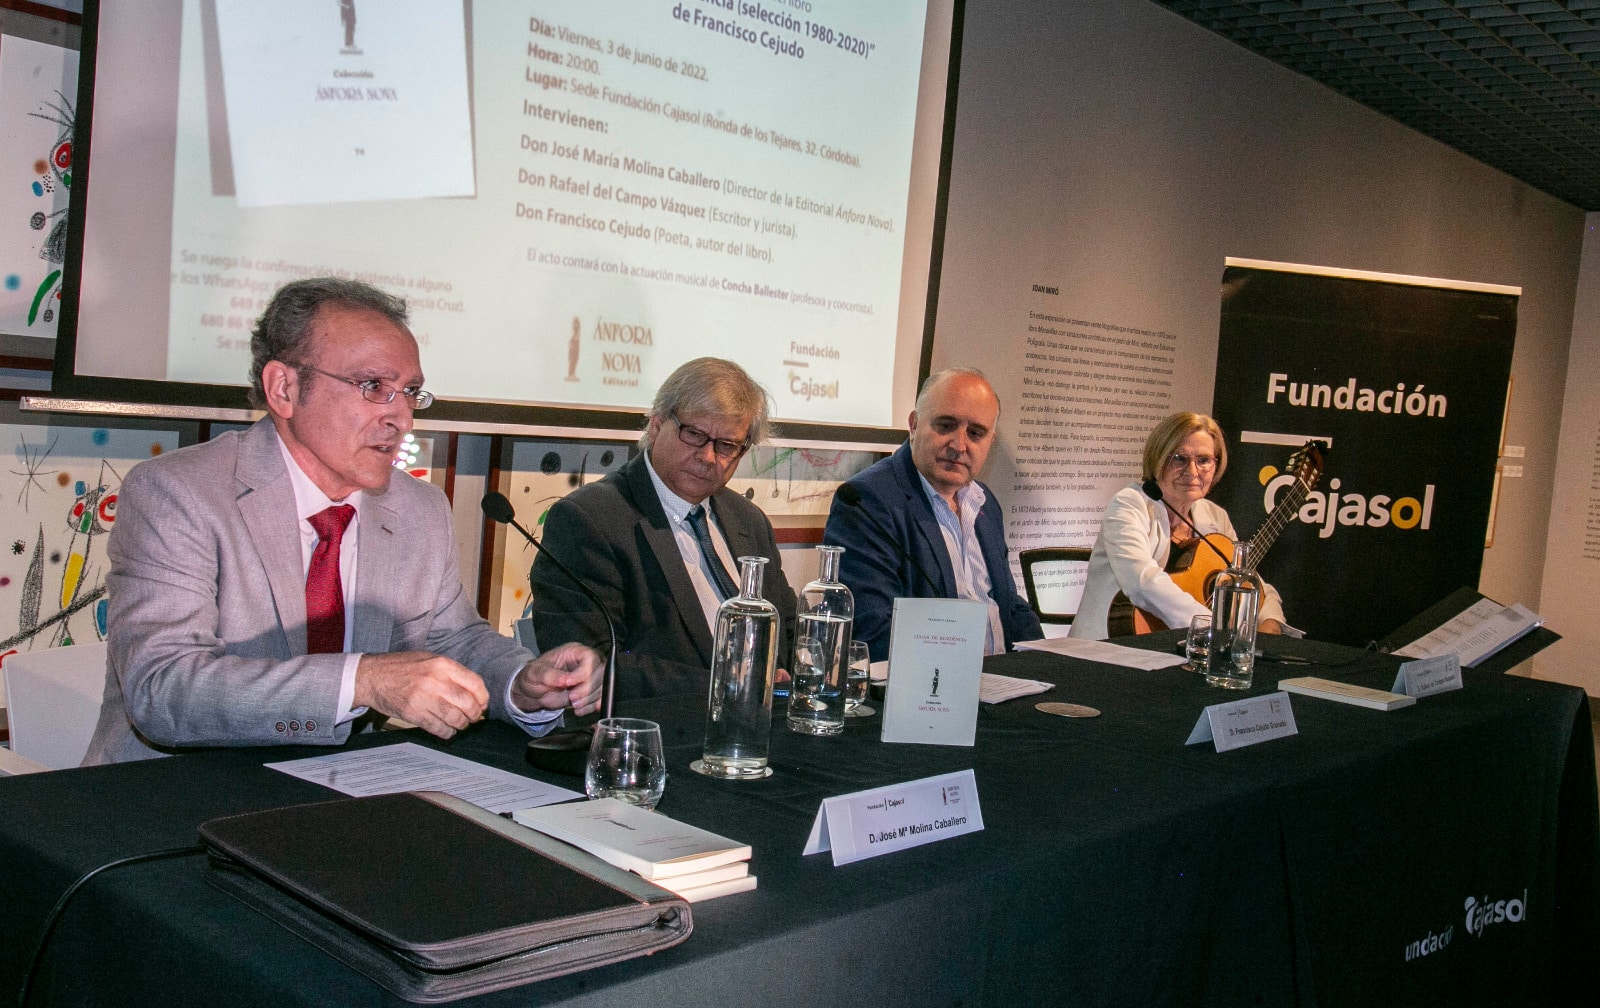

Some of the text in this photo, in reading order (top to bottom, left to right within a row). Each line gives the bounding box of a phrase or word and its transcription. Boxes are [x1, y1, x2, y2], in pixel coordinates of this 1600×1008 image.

[672, 3, 804, 59] de Francisco Cejudo
[738, 0, 801, 33] (selección
[527, 42, 601, 75] Hora: 20:00.
[529, 16, 709, 82] Día: Viernes, 3 de junio de 2022.
[523, 99, 609, 133] Intervienen:
[526, 66, 567, 91] Lugar:
[570, 77, 599, 99] Sede
[602, 87, 661, 114] Fundación
[663, 102, 700, 124] Cajasol
[703, 112, 738, 134] (Ronda
[740, 123, 753, 138] de
[755, 127, 768, 142] los
[770, 130, 802, 153] Tejares,
[820, 144, 861, 168] Córdoba).
[520, 134, 895, 233] Don José María Molina Caballero (Director de la Editorial Ánfora Nova).
[518, 168, 798, 240] Don Rafael del Campo Vázquez (Escritor y jurista).
[515, 202, 775, 263] Don Francisco Cejudo (Poeta, autor del libro).
[416, 277, 452, 293] alguno
[527, 247, 875, 316] El acto contará con la actuación musical de Concha Ballester (profesora y concertista).
[1032, 284, 1045, 294] JOAN
[593, 315, 653, 347] ÁNFORA
[602, 352, 641, 374] NOVA
[790, 340, 840, 360] Fundación
[788, 373, 839, 402] Cajasol
[1267, 372, 1448, 418] Fundación
[1262, 473, 1436, 539] Cajasol
[888, 798, 905, 808] Cajasol
[869, 833, 878, 844] D.
[880, 829, 897, 842] José
[909, 823, 933, 836] Molina
[934, 816, 967, 830] Caballero
[1464, 888, 1527, 938] Cajasol
